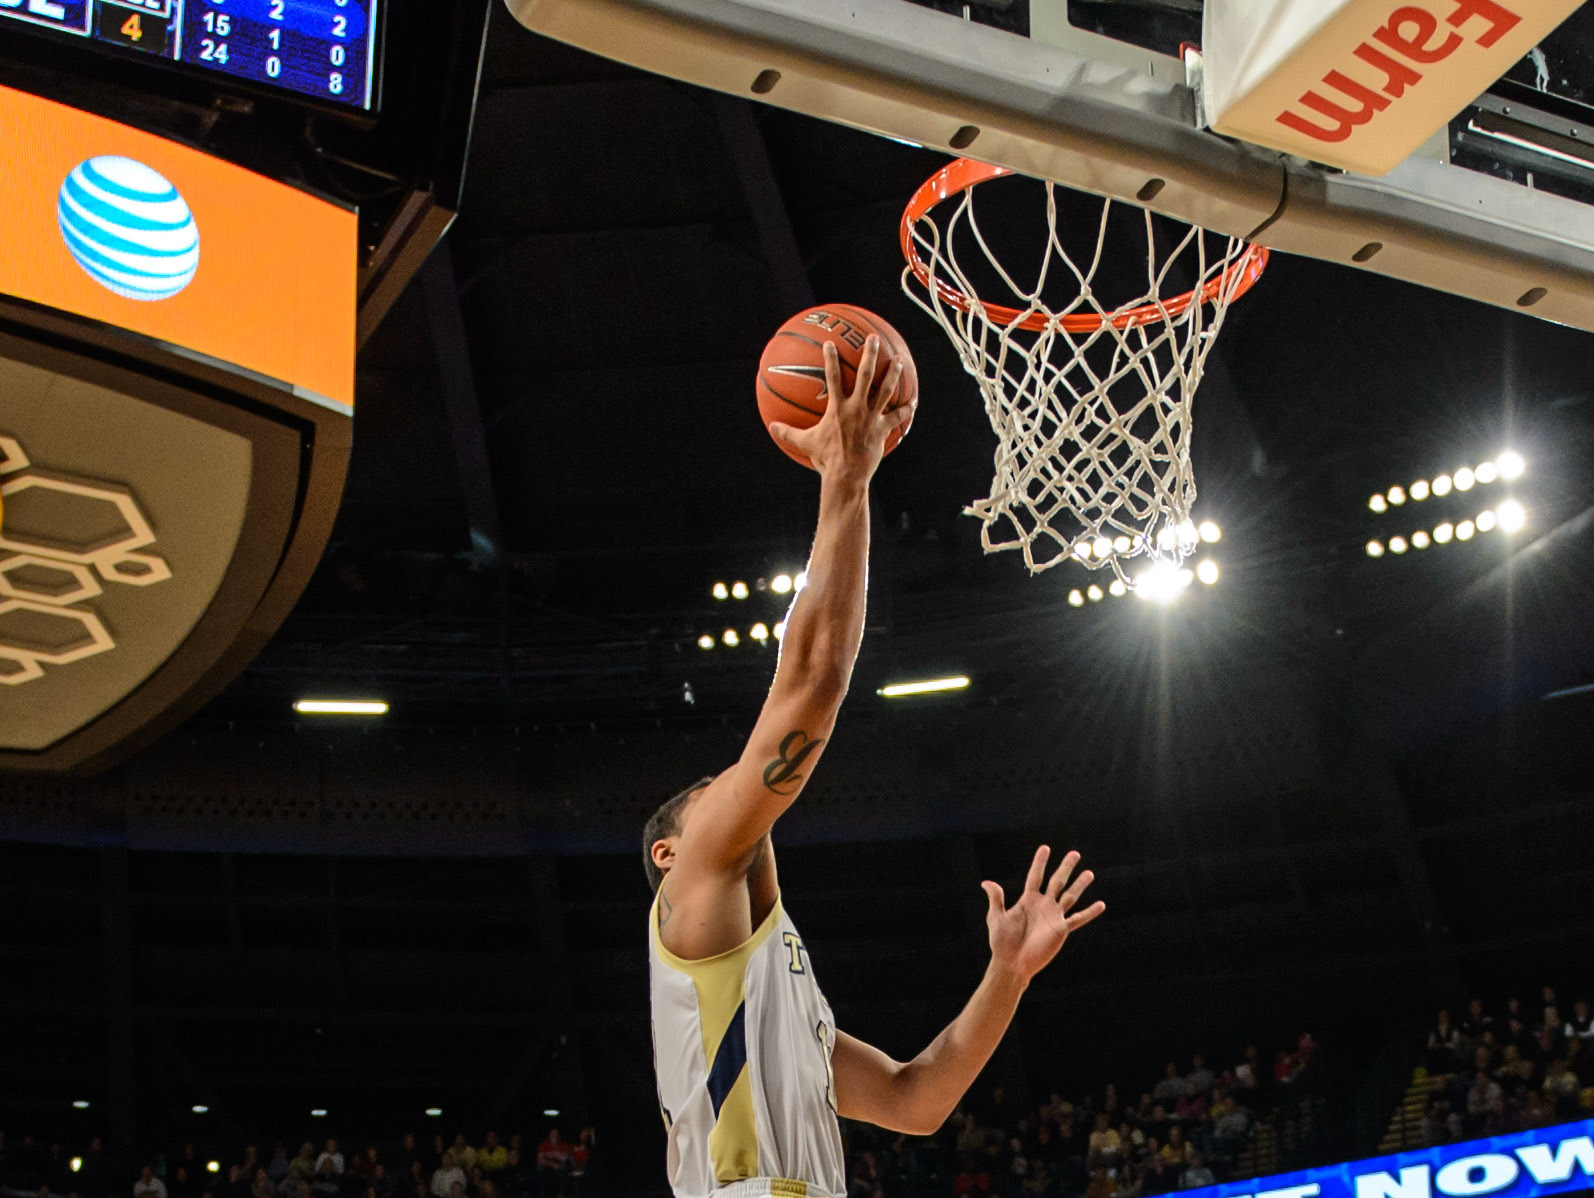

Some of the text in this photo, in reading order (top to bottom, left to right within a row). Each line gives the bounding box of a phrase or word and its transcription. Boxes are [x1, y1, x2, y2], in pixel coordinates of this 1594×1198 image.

[121, 13, 143, 42] 4
[203, 11, 346, 66] 15 1 0
[331, 15, 347, 38] 2
[200, 38, 344, 94] 24 0 8
[1275, 0, 1523, 143] Farm
